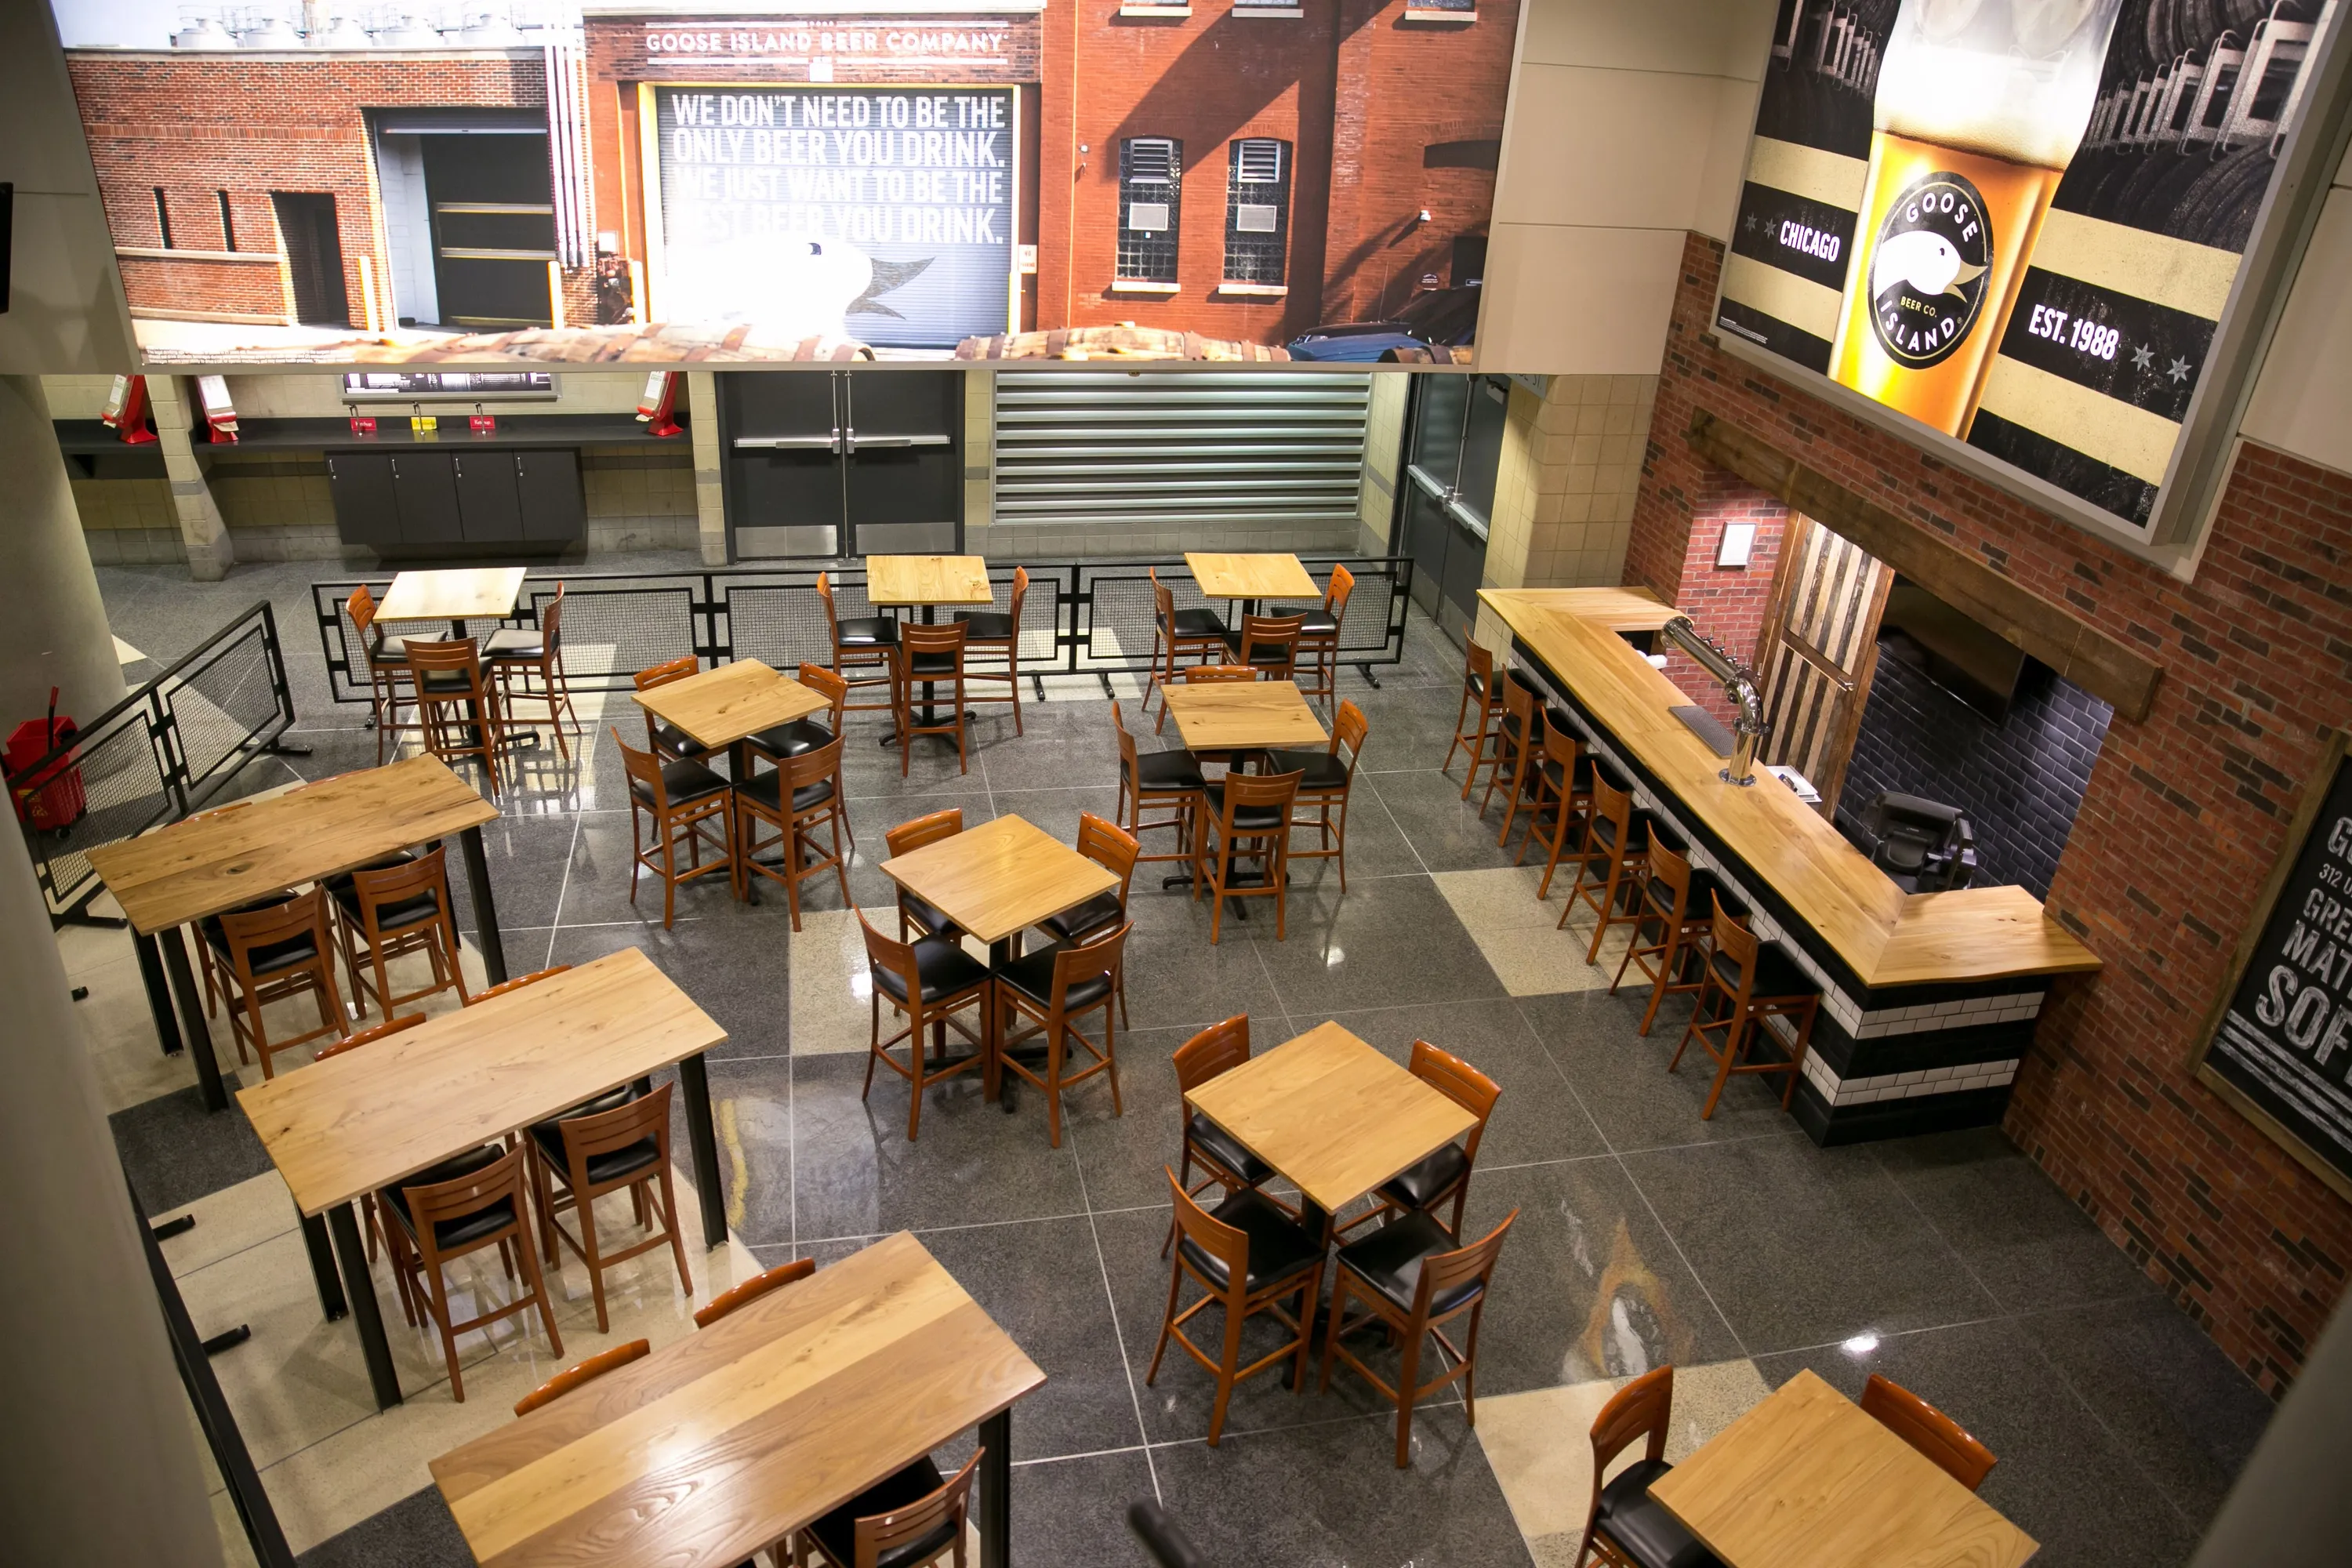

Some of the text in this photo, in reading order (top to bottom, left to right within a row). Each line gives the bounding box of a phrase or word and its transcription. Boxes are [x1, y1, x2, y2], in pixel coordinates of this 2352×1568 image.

[646, 33, 722, 51] GOOSE
[731, 33, 812, 51] ISLAND
[822, 33, 877, 50] BEER
[672, 94, 1005, 129] WE DON'T NEED TO BE THE
[673, 128, 1005, 168] ONLY BEER YOU DRINK.
[722, 167, 780, 203] JUST
[787, 168, 867, 202] WANT
[871, 169, 906, 202] TO
[913, 170, 947, 202] BE
[952, 171, 1003, 204] THE
[830, 205, 892, 243] YOU
[902, 208, 1004, 245] DRINK.
[1906, 192, 1977, 242] GOOSE
[1780, 220, 1840, 262] CHICAGO
[1880, 300, 1955, 351] ISLAND
[1900, 296, 1938, 318] BEER CO.
[2028, 303, 2119, 360] EST. 1988
[2318, 863, 2343, 888] 312
[2303, 887, 2352, 946] GRE
[2281, 919, 2352, 1002] MAT
[2256, 964, 2352, 1087] SOF
